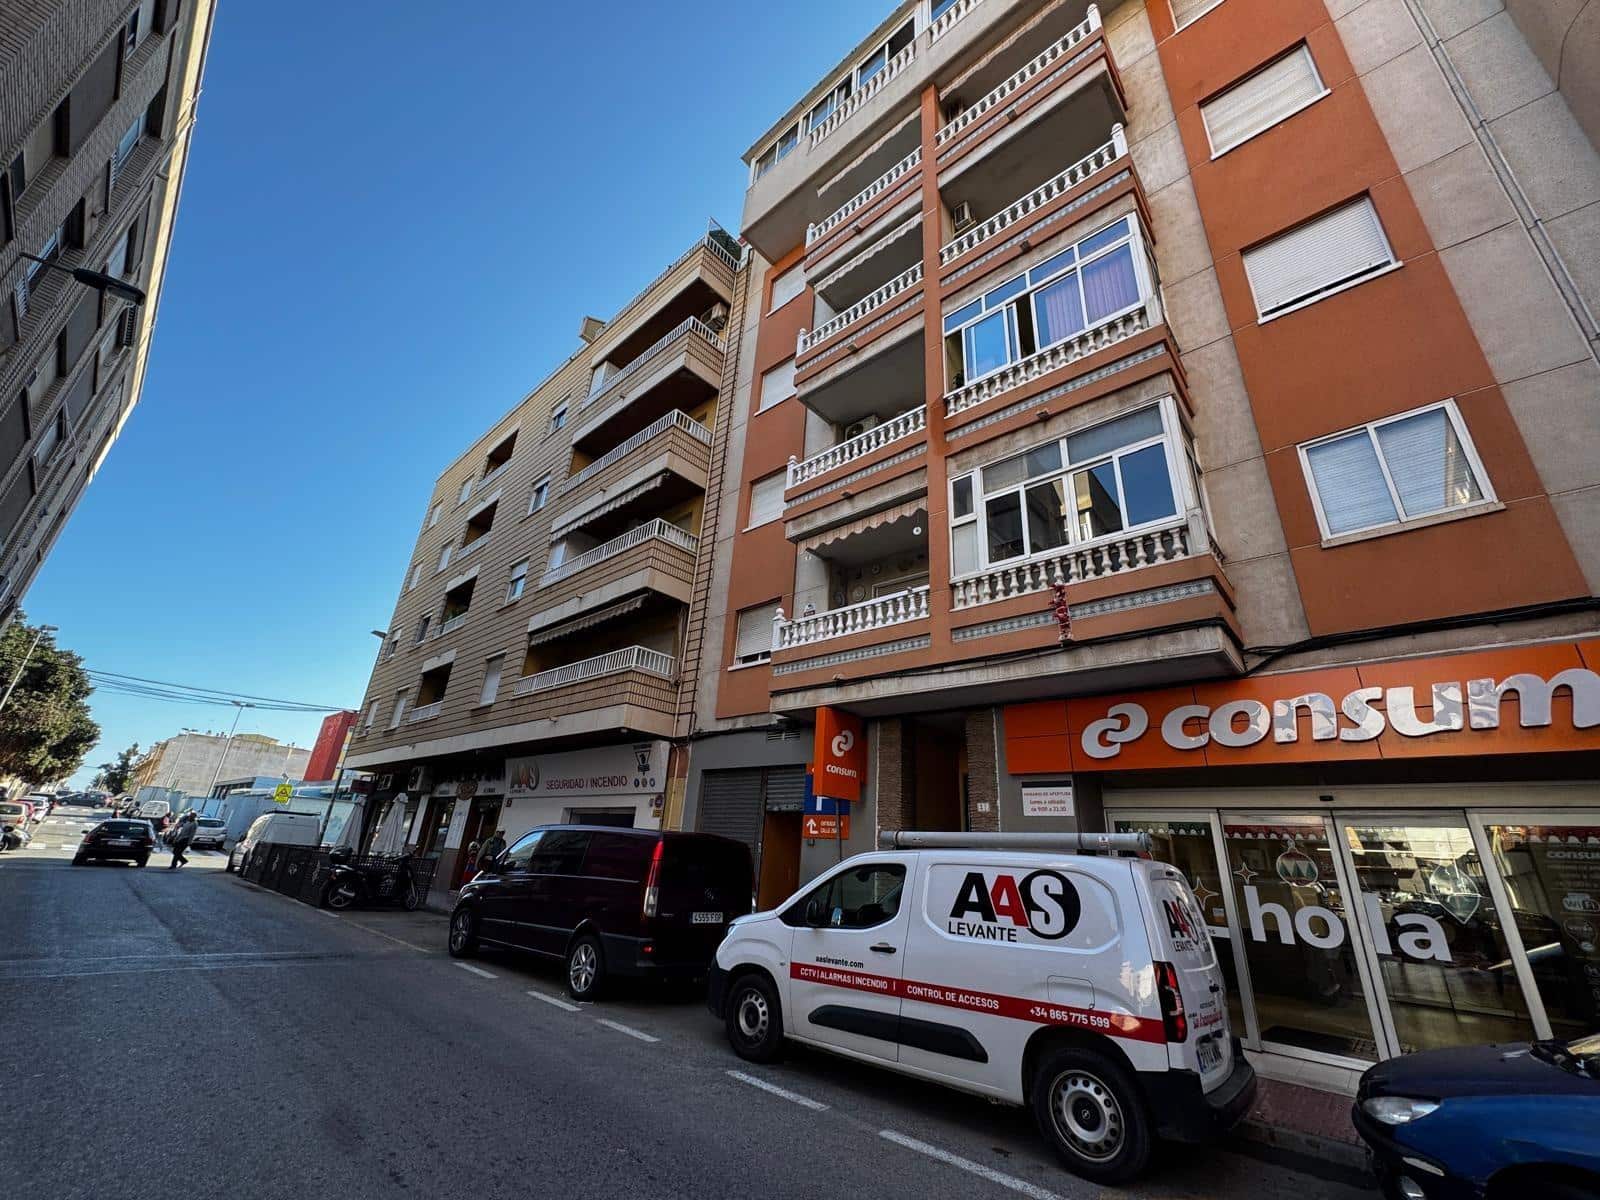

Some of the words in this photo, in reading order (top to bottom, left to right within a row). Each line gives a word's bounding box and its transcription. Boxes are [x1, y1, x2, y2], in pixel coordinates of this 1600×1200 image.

[1161, 667, 1600, 751] consum
[826, 763, 857, 778] consum
[546, 776, 585, 790] SEGURIDAD
[590, 775, 628, 788] INCENDIO
[949, 869, 1081, 940] AAS
[948, 921, 1017, 943] LEVANTE
[1243, 884, 1453, 963] hola
[815, 955, 864, 969] aaslevante.com
[800, 967, 817, 977] CCTV
[820, 971, 851, 984] ALARMAS
[855, 977, 888, 990] INCENDIO
[907, 985, 944, 1001] CONTROL
[945, 993, 957, 1002] DE
[958, 994, 1000, 1010] ACCESOS
[1029, 1006, 1048, 1018] +34
[1049, 1009, 1068, 1021] 865
[1070, 1012, 1088, 1025] 775
[1090, 1016, 1110, 1029] 599
